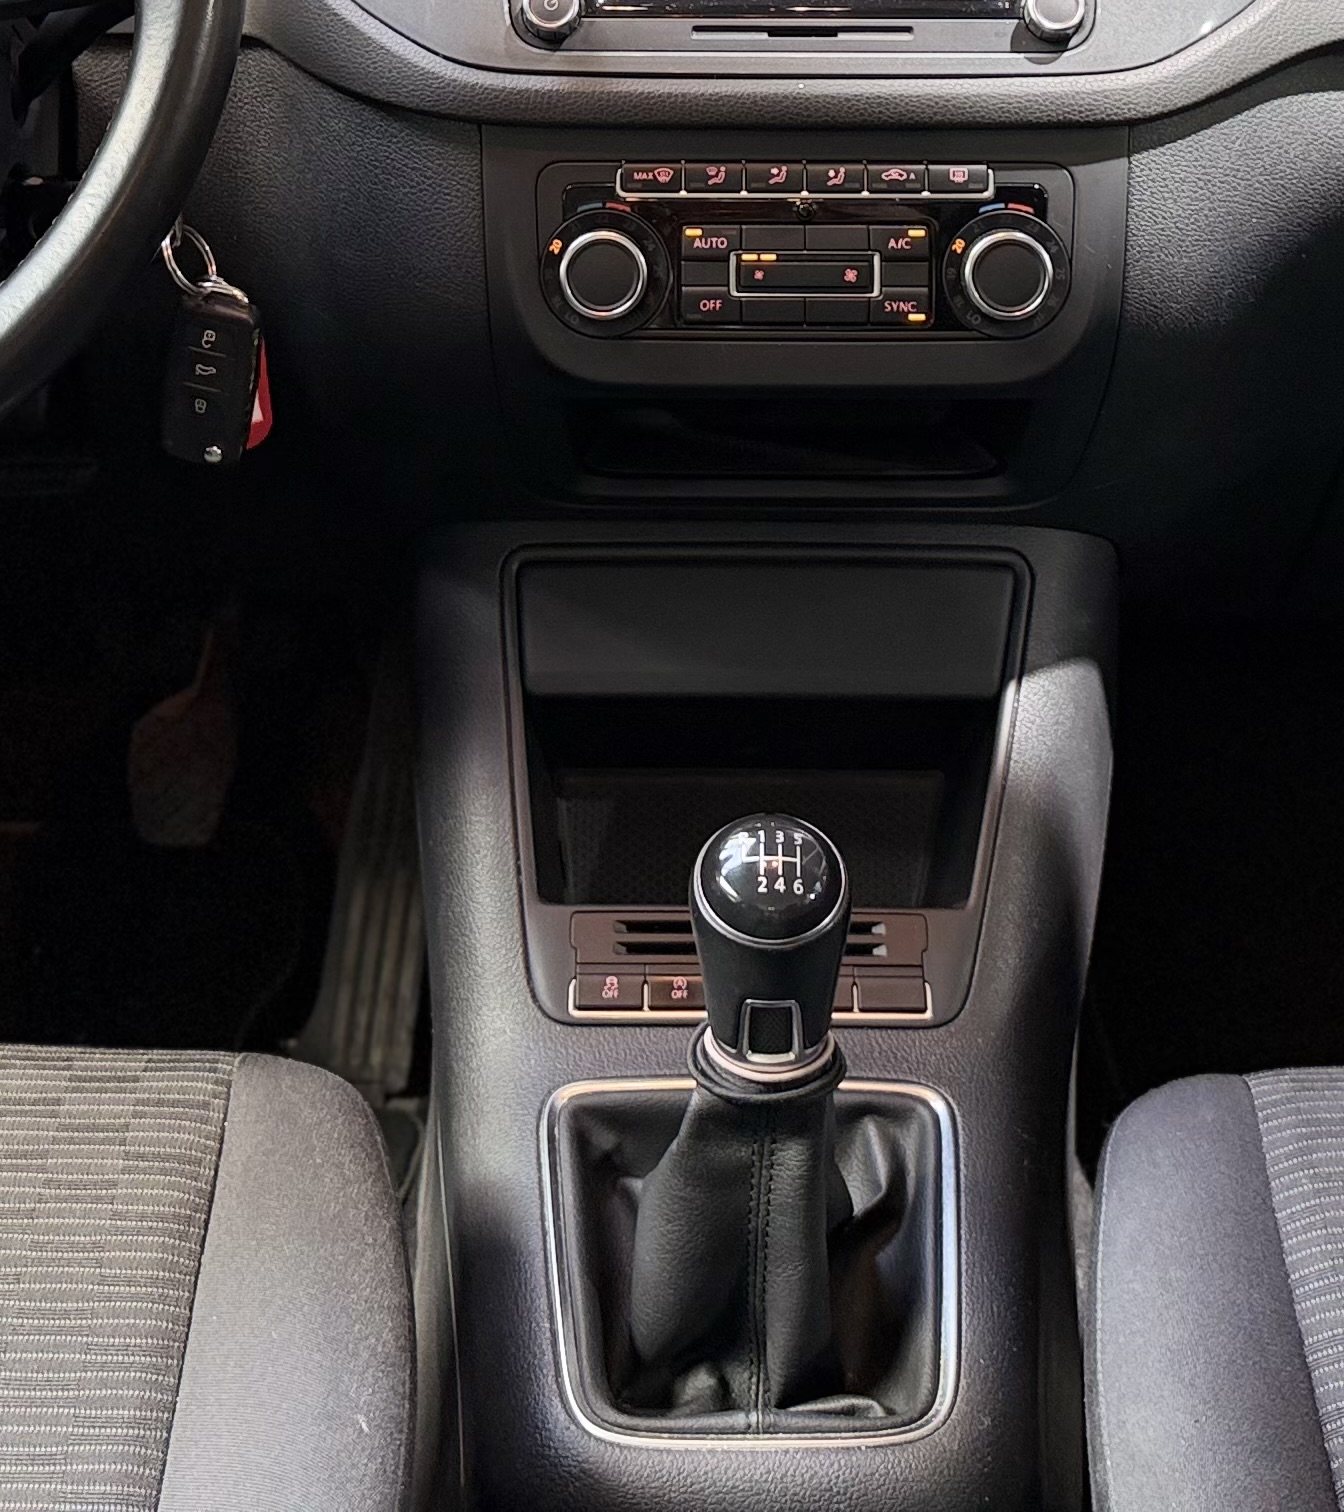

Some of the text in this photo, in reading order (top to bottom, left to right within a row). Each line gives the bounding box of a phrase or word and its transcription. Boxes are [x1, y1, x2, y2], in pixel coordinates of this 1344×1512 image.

[633, 171, 654, 181] MAX
[693, 237, 728, 249] AUTO
[887, 237, 912, 250] A/C
[699, 299, 723, 311] OFF
[883, 300, 918, 313] SYNC
[757, 830, 766, 843] 1
[775, 830, 785, 843] 3
[793, 832, 803, 845] 5
[757, 875, 804, 895] 2 4 6
[601, 989, 619, 999] OFF
[670, 989, 689, 999] OFF
